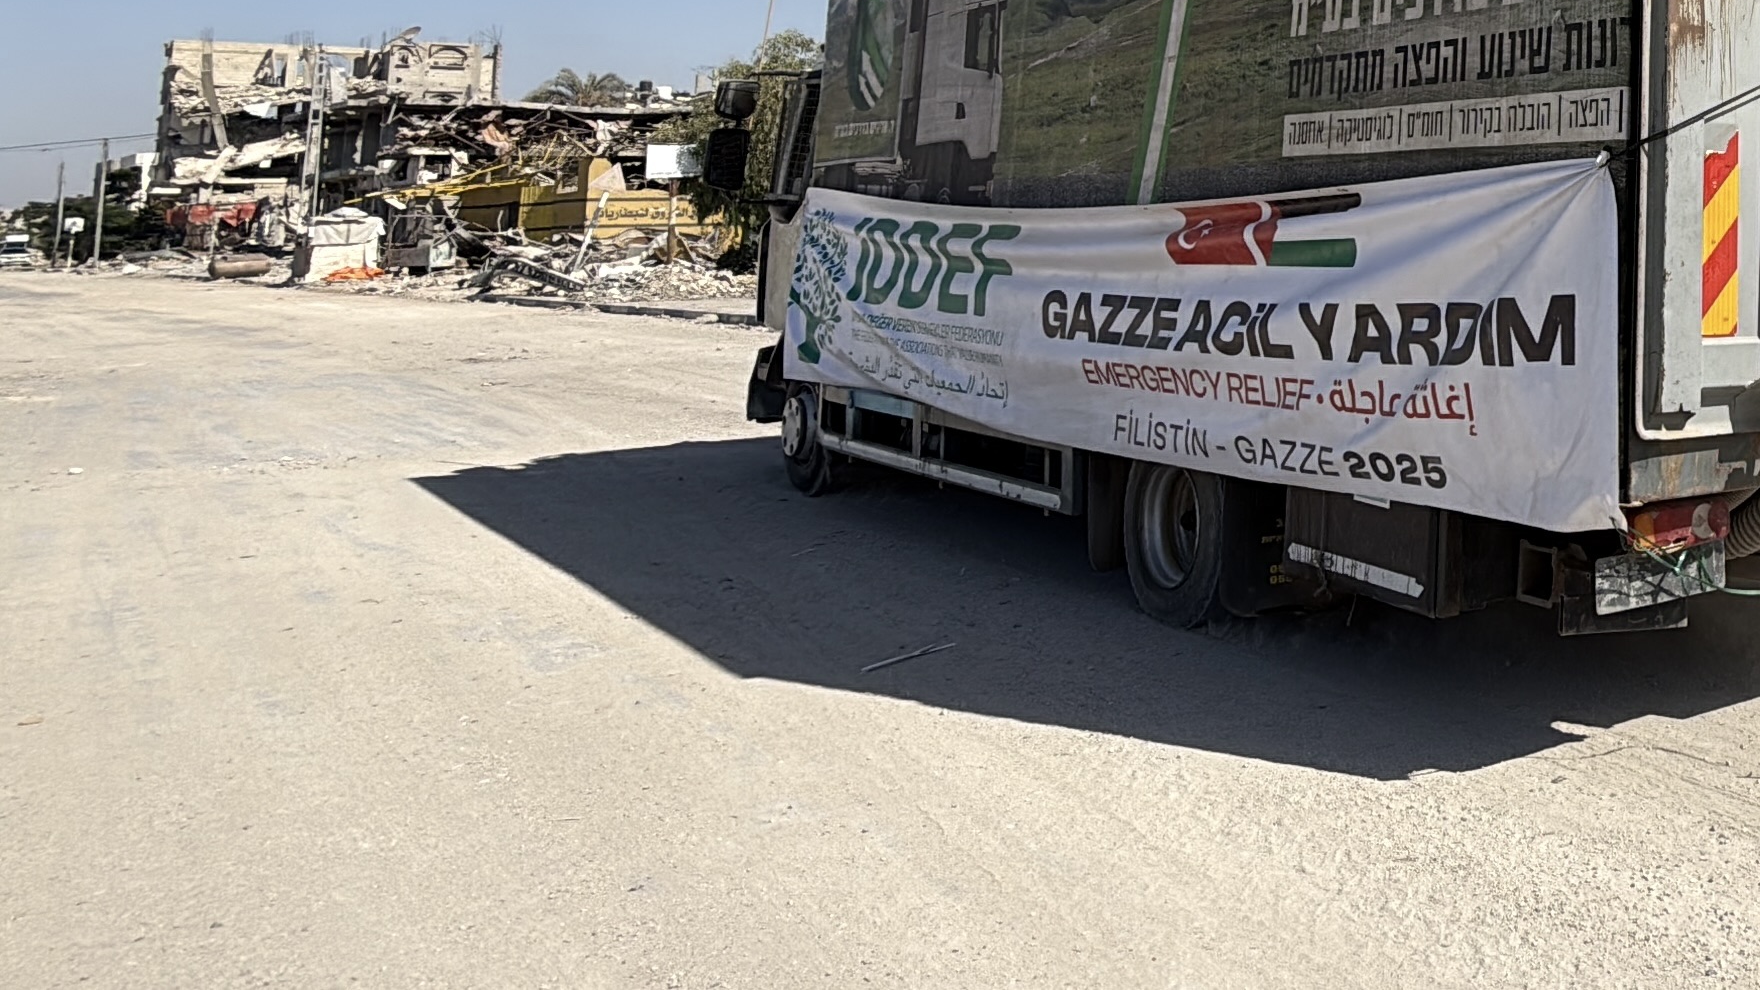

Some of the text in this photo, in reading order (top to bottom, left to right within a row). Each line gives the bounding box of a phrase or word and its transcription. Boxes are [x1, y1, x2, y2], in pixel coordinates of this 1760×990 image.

[1288, 48, 1384, 101] מתקדמים
[1393, 37, 1467, 89] והפצה
[1477, 25, 1553, 81] שינוע
[1289, 120, 1324, 146] אחסנה
[1337, 114, 1393, 147] לוגיסטיקה
[1458, 106, 1502, 138] בקירור
[1508, 101, 1551, 132] הובלה
[1569, 96, 1611, 129] הפצה
[1042, 289, 1181, 351] GAZZE
[1174, 300, 1294, 358] ACİL
[1082, 359, 1315, 409] EMERGENCY RELIEF
[1329, 379, 1401, 424] عاجلة
[1113, 409, 1208, 459] FİLİSTİN
[1234, 435, 1340, 477] GAZZE
[1343, 451, 1447, 489] 2025
